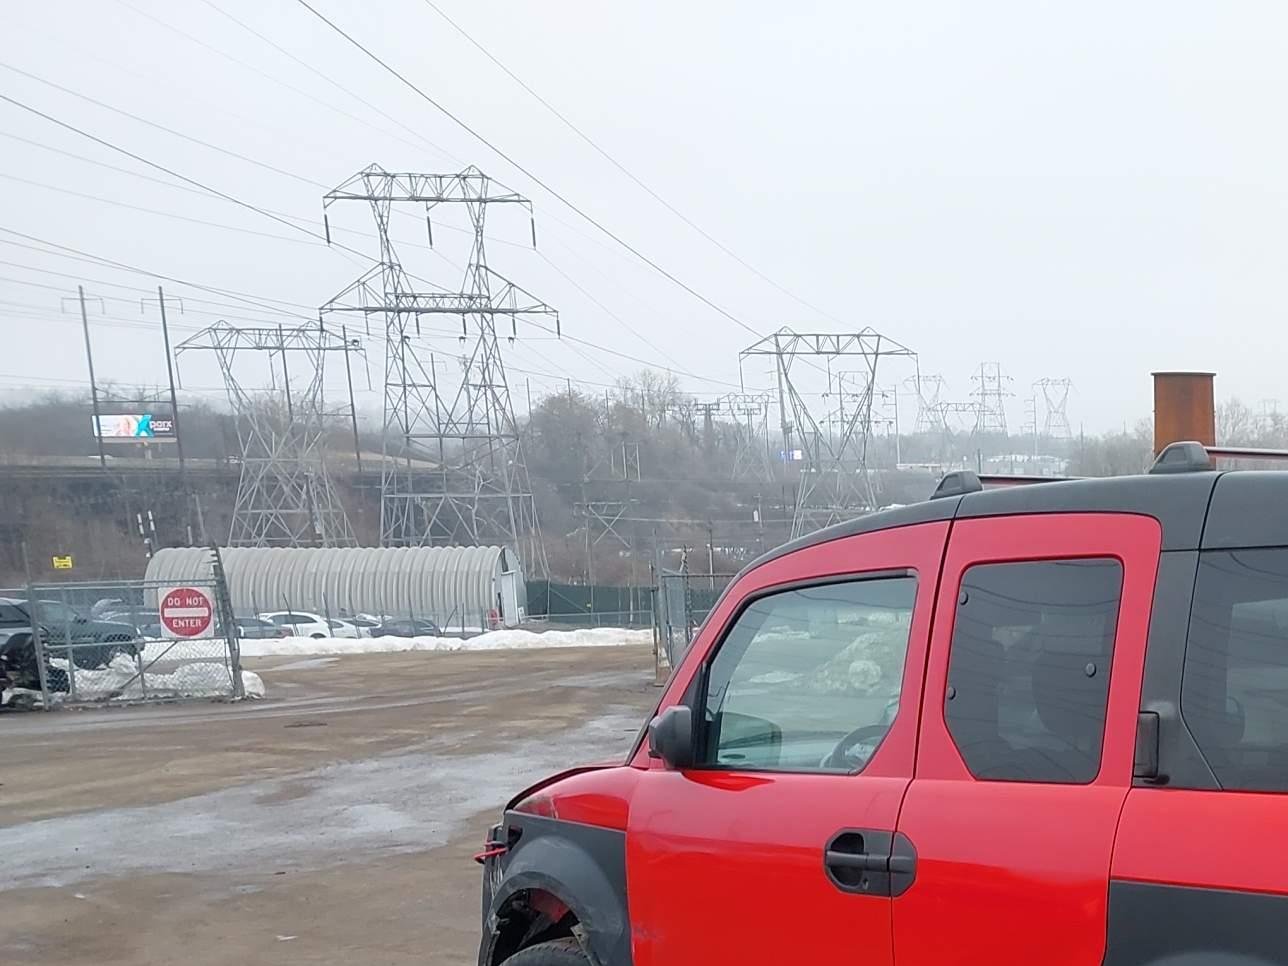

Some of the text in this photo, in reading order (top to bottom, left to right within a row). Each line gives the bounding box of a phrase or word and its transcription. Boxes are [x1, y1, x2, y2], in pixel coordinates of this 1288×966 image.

[167, 596, 204, 606] DO NOT
[172, 618, 202, 628] ENTER
